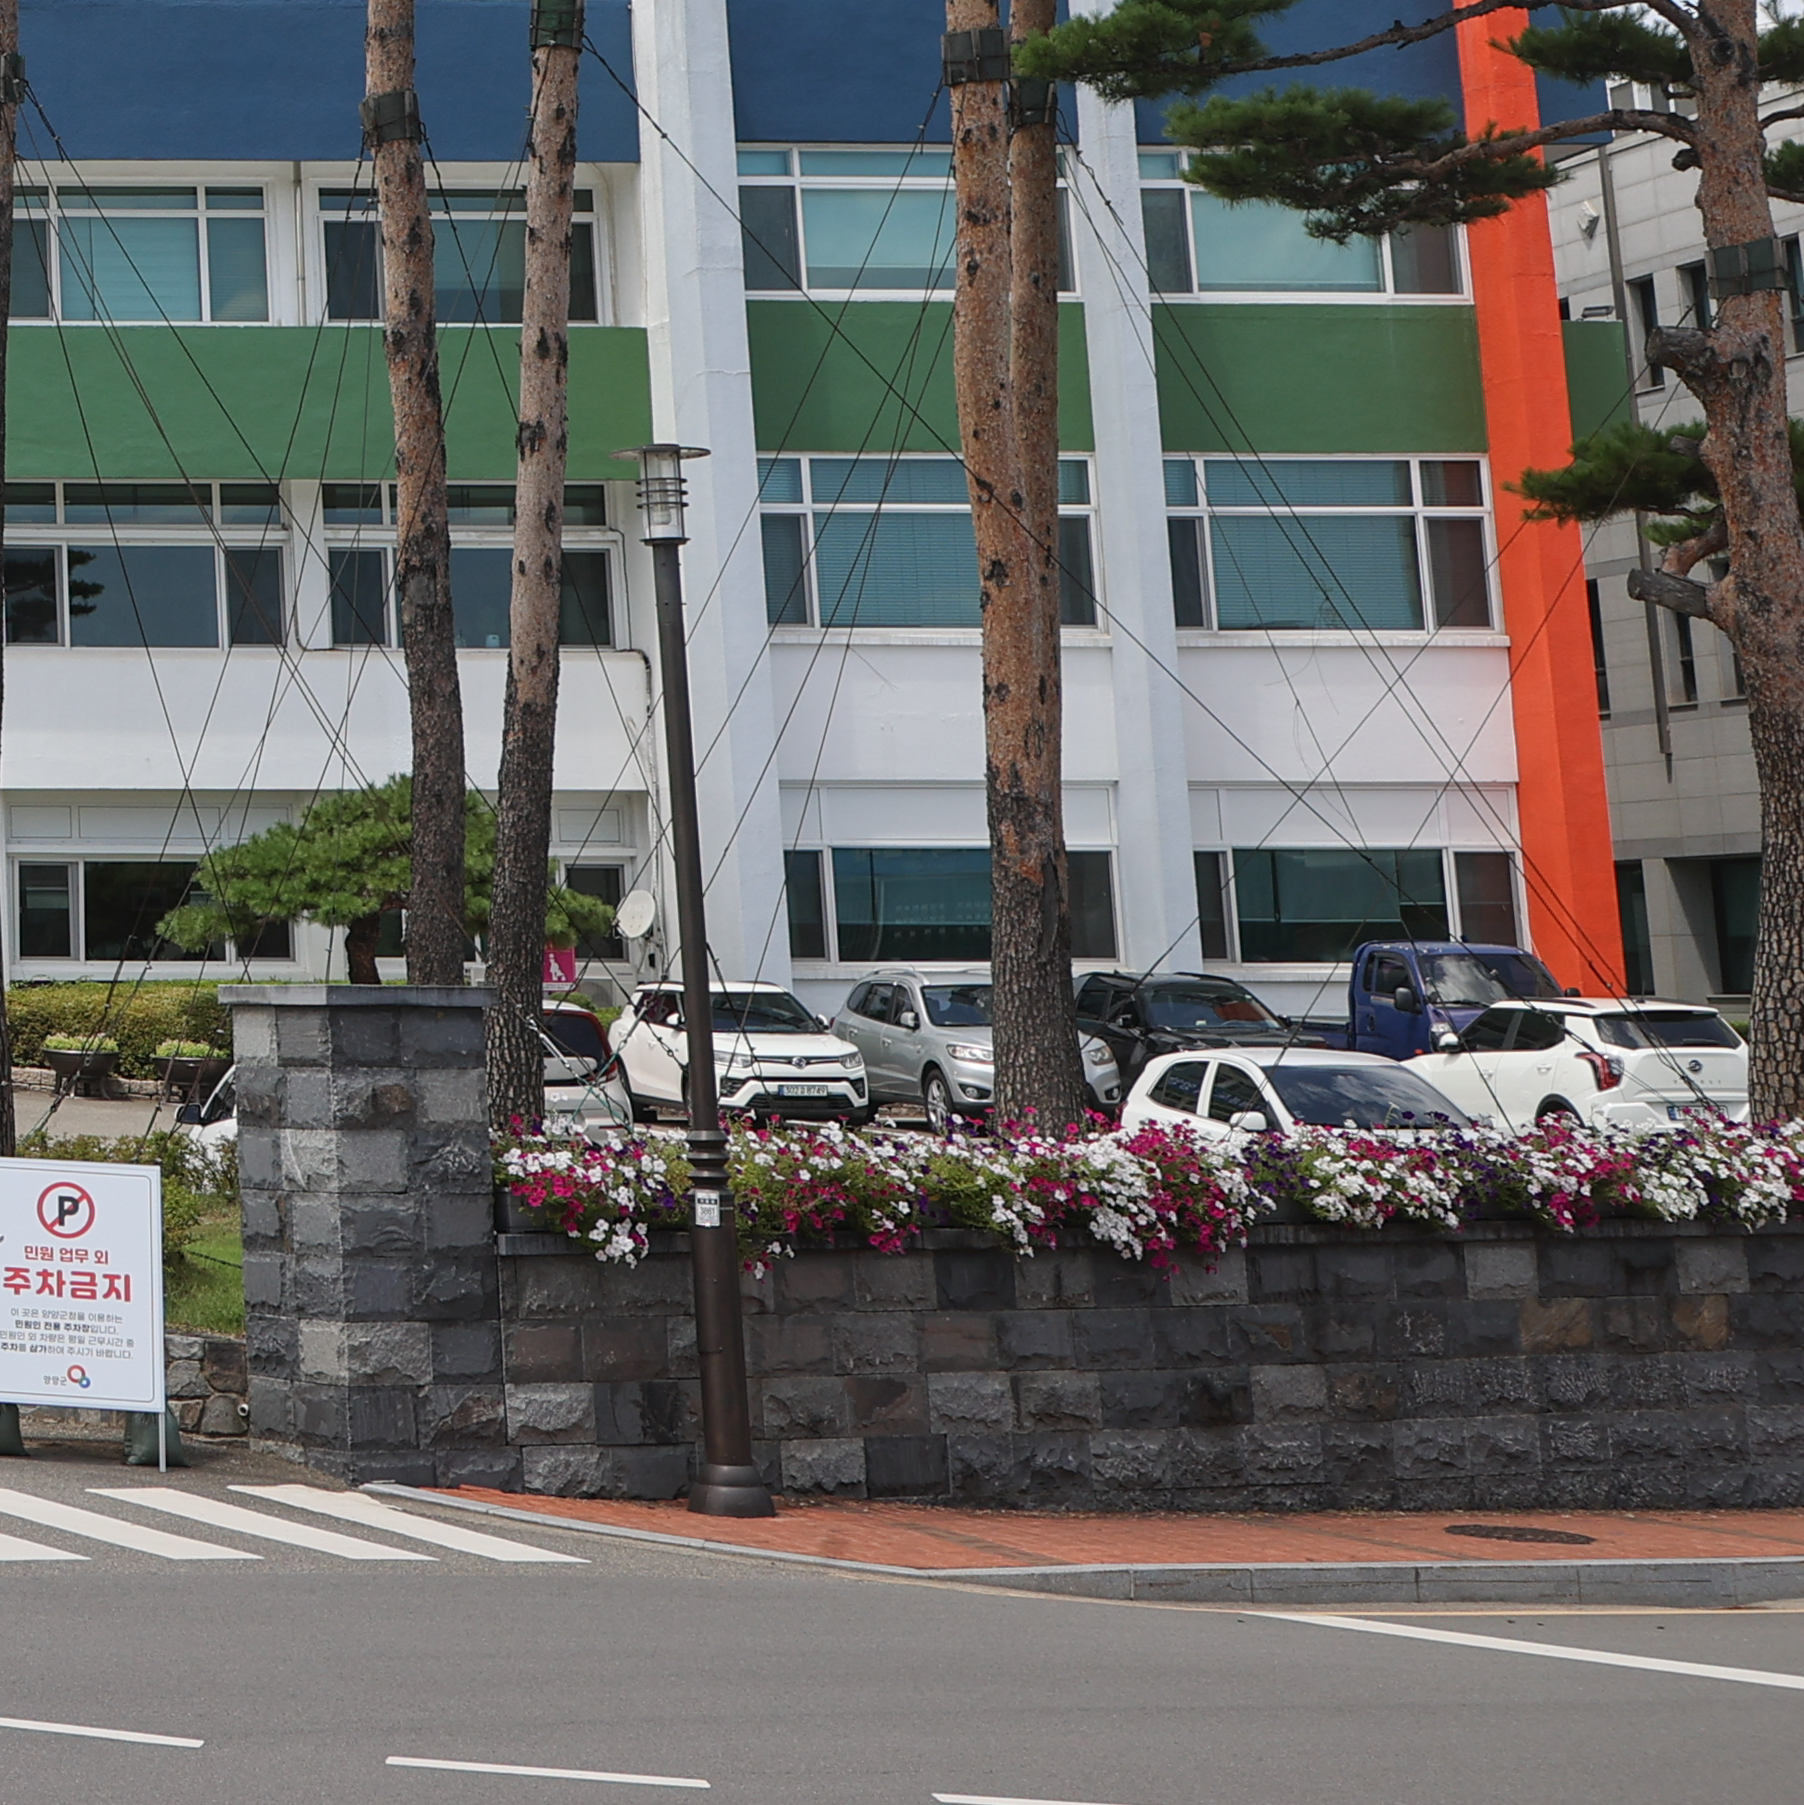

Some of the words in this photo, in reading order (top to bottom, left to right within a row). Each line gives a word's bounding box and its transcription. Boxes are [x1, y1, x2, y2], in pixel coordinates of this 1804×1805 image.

[24, 1245, 55, 1262] 민원
[59, 1247, 90, 1264] 업무
[94, 1249, 109, 1266] 외
[3, 1266, 131, 1302] 주차금지
[10, 1308, 20, 1317] 이
[88, 1312, 123, 1324] 이용하는
